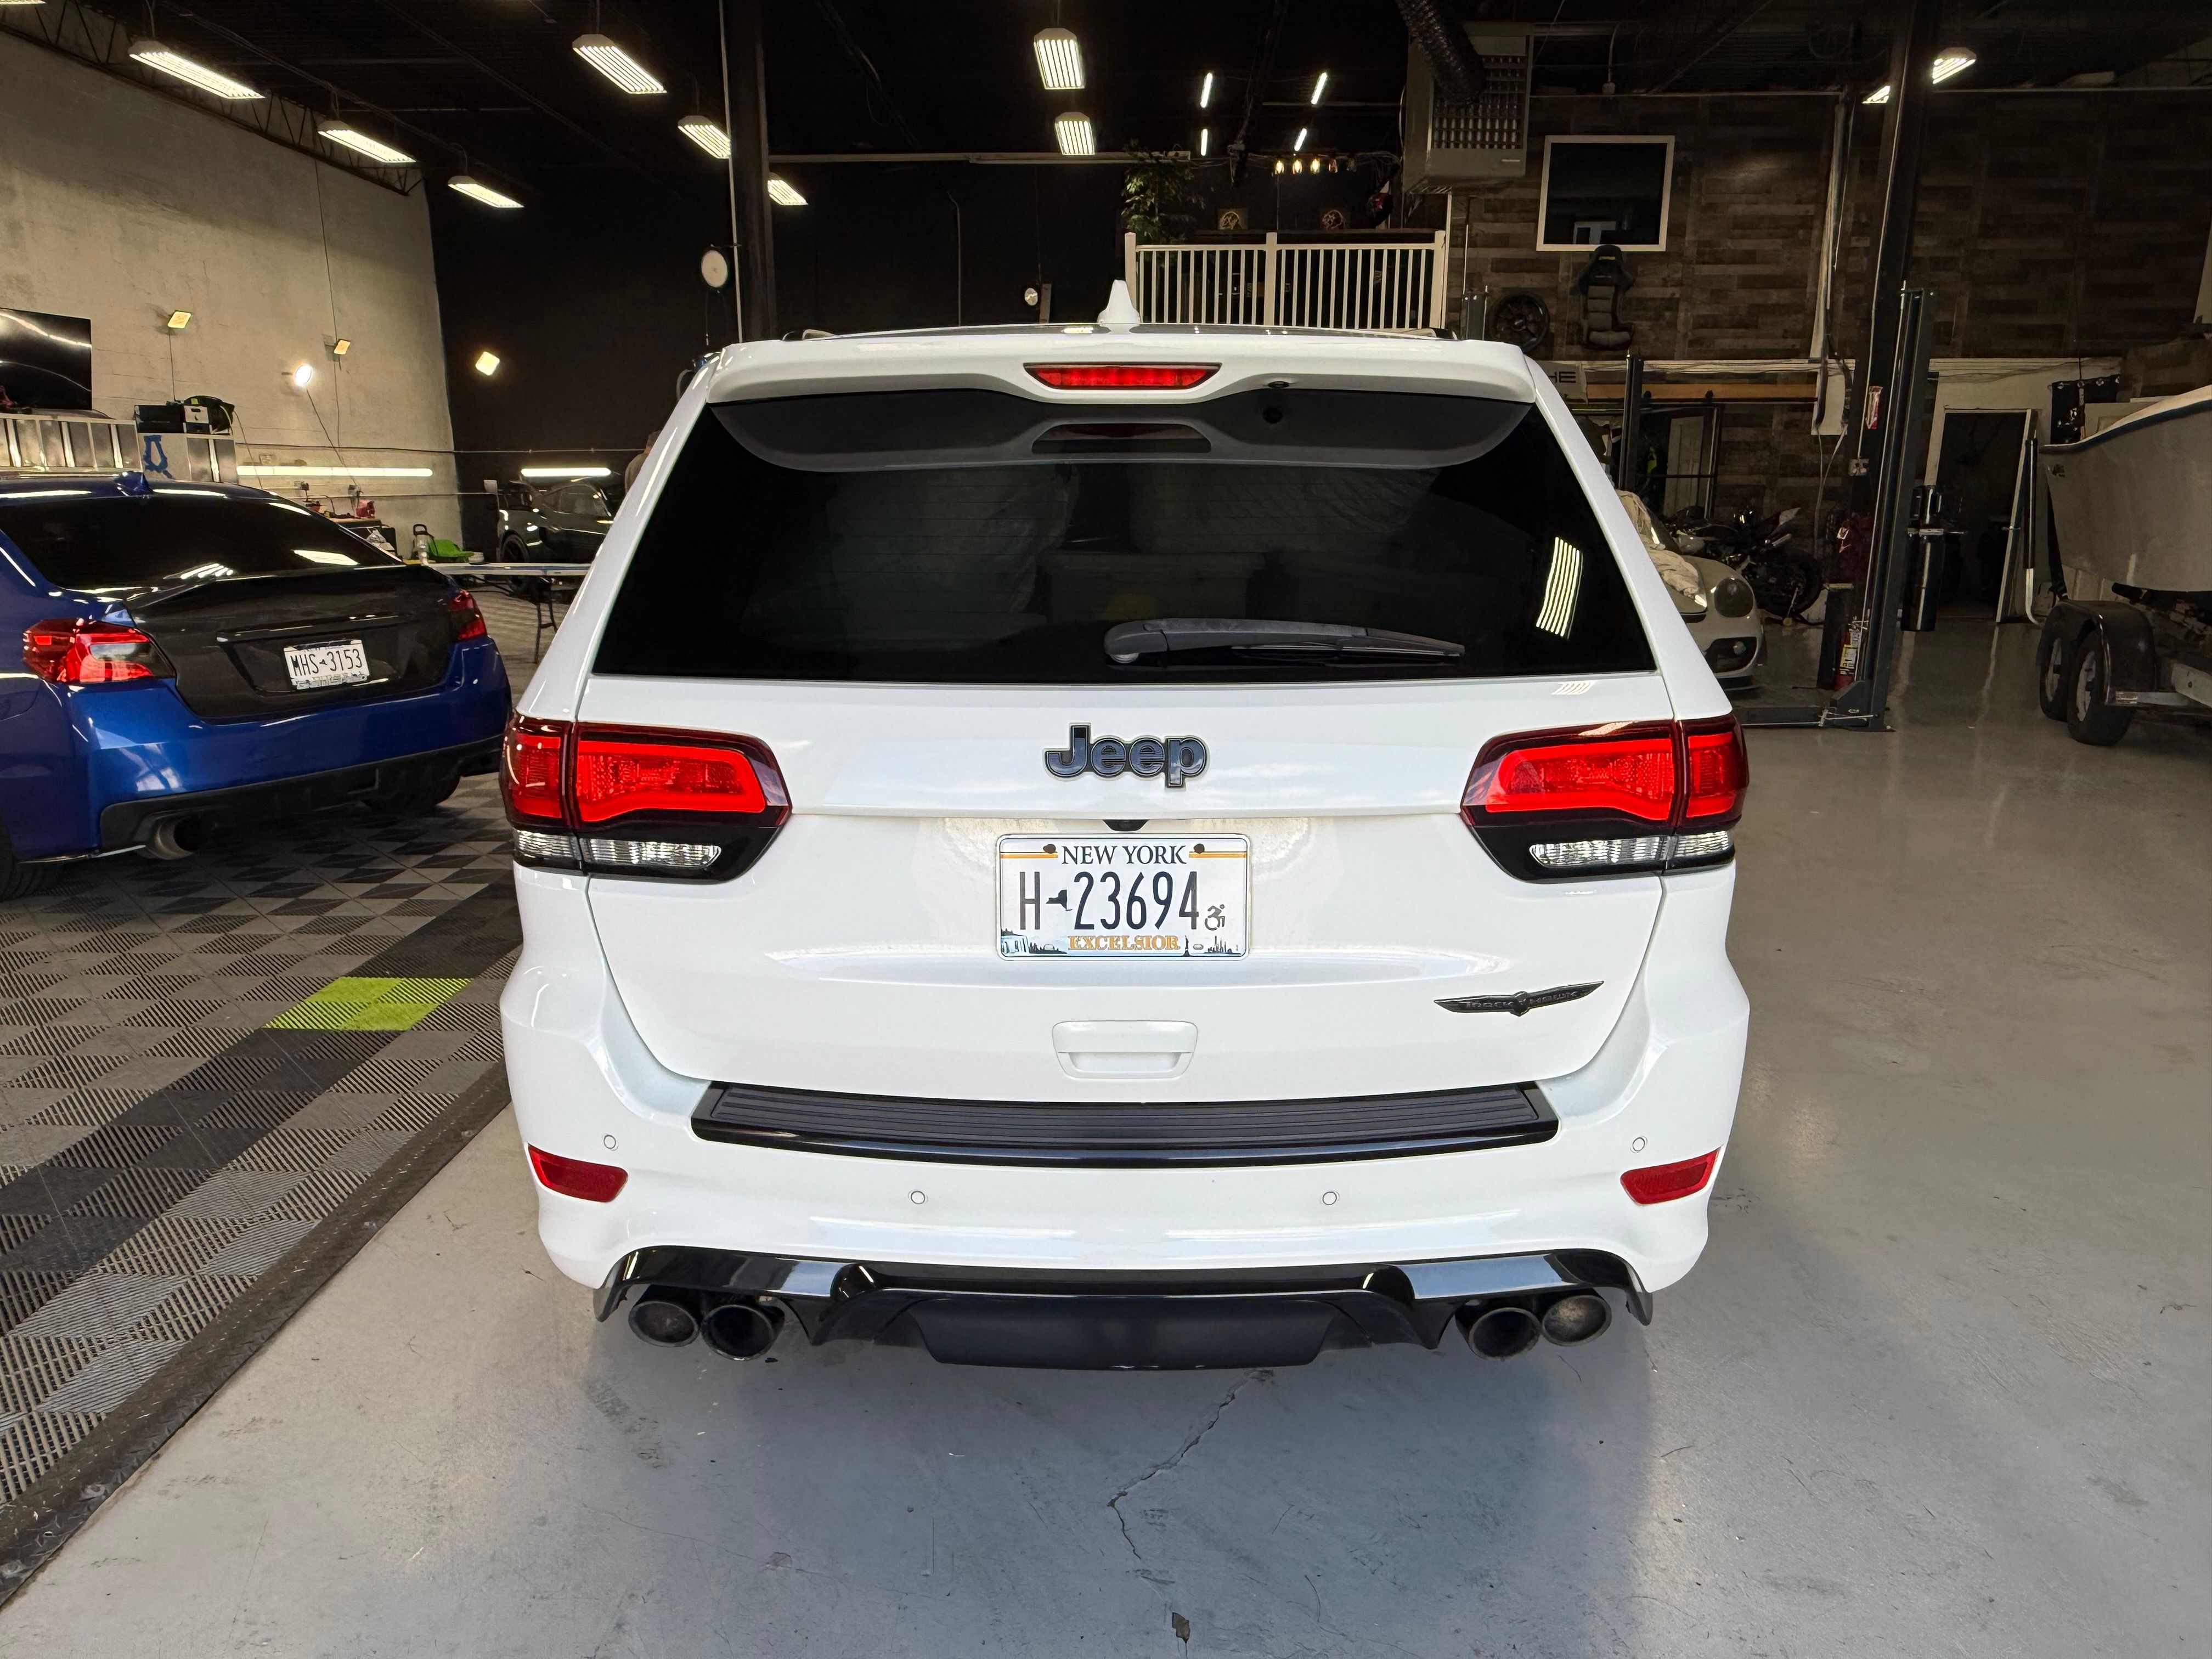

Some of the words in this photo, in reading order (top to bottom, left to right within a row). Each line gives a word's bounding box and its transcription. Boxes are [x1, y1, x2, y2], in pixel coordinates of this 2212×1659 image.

[290, 653, 319, 676] MHS
[326, 648, 363, 672] 3153
[1044, 724, 1207, 788] Jeep
[1062, 845, 1118, 865] NEW
[1122, 845, 1187, 865] YORK
[1019, 871, 1041, 930] H
[1073, 871, 1199, 930] 23694
[1067, 935, 1181, 951] EXCELSIOR
